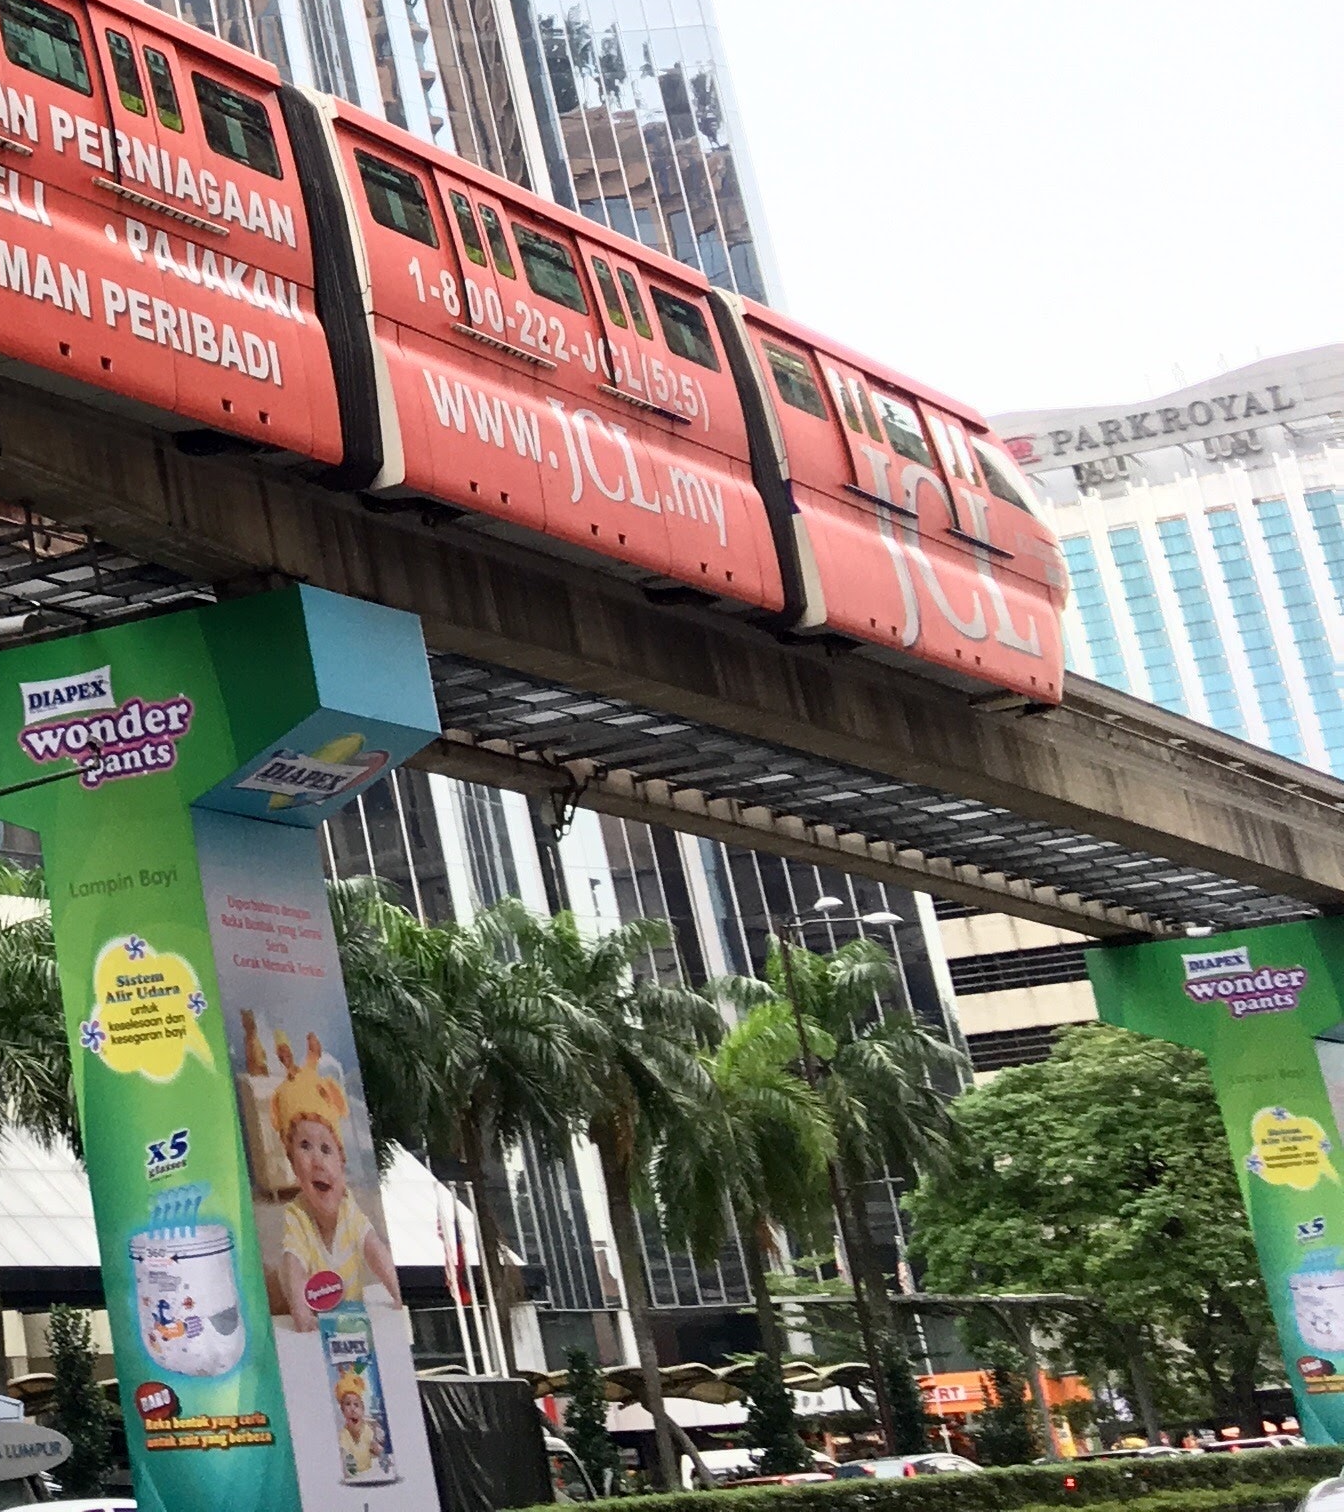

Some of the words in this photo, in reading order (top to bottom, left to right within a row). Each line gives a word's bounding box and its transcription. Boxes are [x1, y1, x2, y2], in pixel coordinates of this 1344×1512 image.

[50, 104, 298, 249] PERNIAGAAN
[125, 215, 306, 325] PAJAKAN
[101, 277, 283, 386] PERIBADI
[1048, 385, 1296, 457] PARKROYAL
[858, 443, 1044, 659] JCL
[28, 679, 107, 710] DIAPEX
[25, 703, 188, 757] wonder
[84, 742, 172, 782] pants
[261, 762, 347, 791] DIAPEX
[69, 872, 134, 899] Lampin
[140, 865, 178, 888] Bayi
[1188, 955, 1245, 972] DIAPEX
[116, 972, 165, 988] Sistem
[137, 983, 181, 1000] Udara
[1188, 969, 1305, 999] wonder
[165, 1013, 186, 1025] dan
[1232, 993, 1295, 1015] pants
[6, 1440, 63, 1459] LUMPUR
